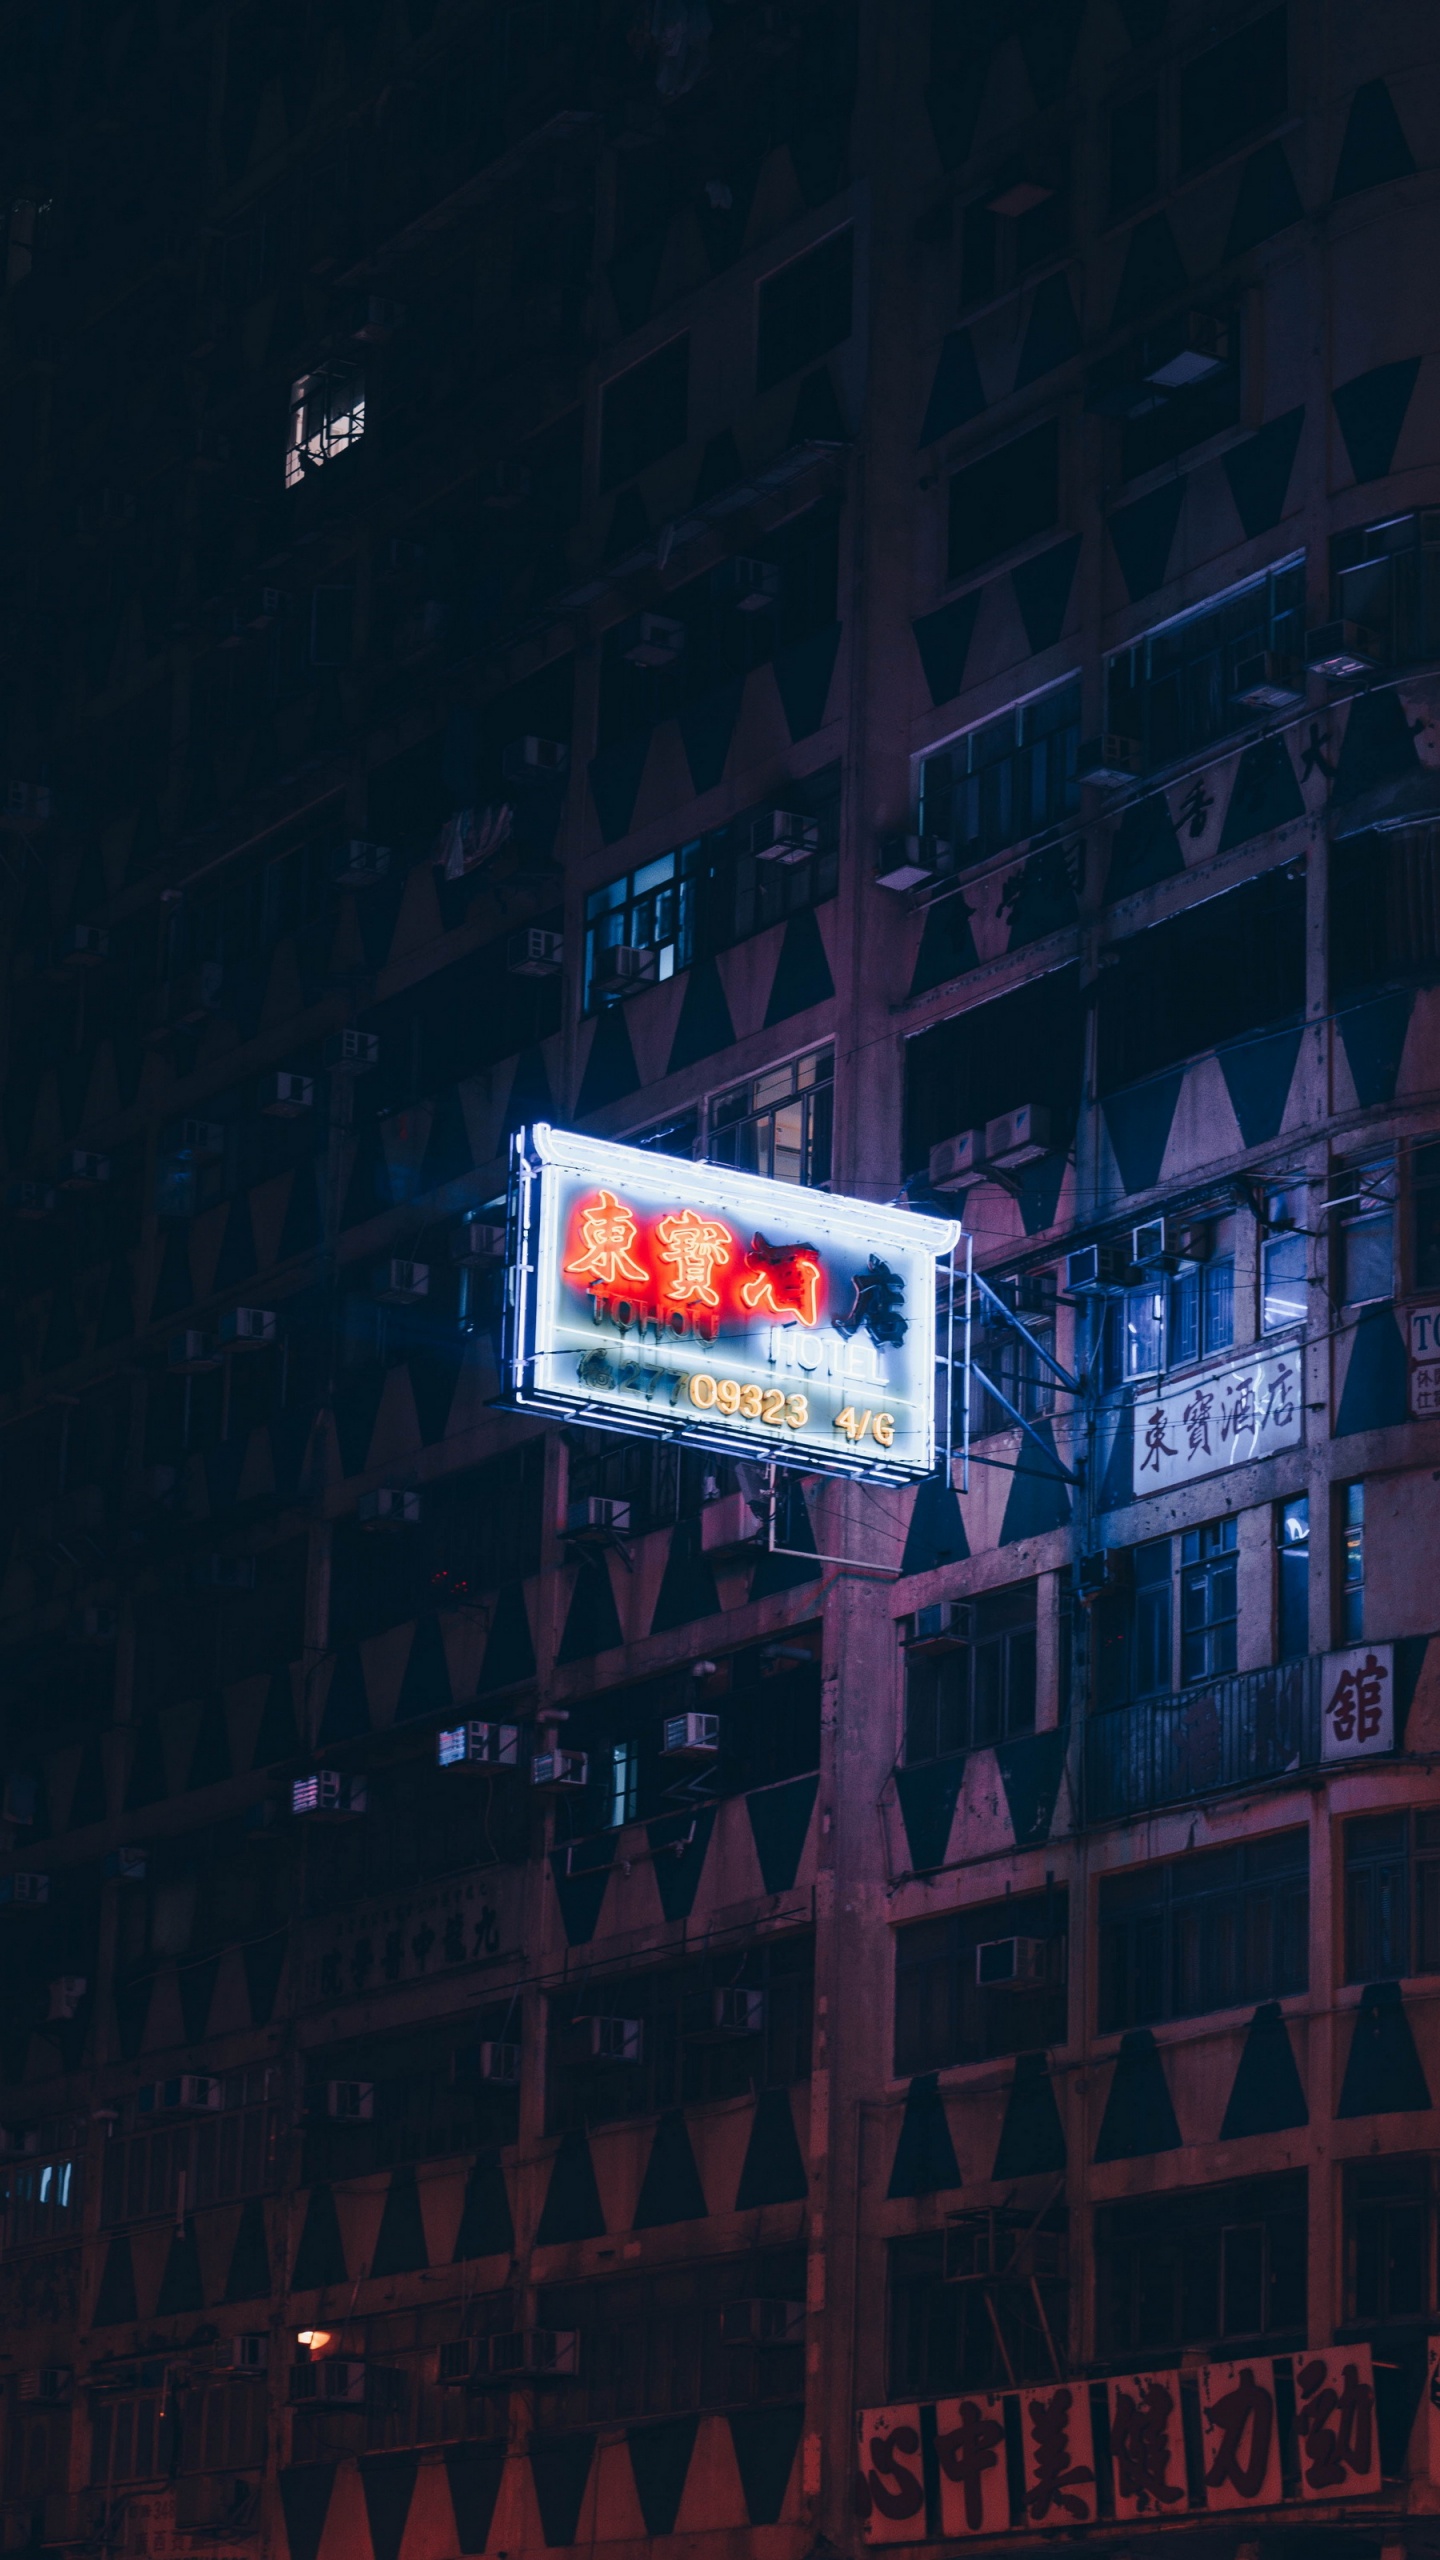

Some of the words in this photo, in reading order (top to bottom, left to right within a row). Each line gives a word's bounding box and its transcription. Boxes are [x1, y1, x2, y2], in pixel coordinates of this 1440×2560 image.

[566, 1189, 908, 1349] 東寶酒店
[586, 1288, 720, 1348] TOHOU
[770, 1328, 890, 1386] HOTEL
[1140, 1362, 1295, 1473] 東寶酒店
